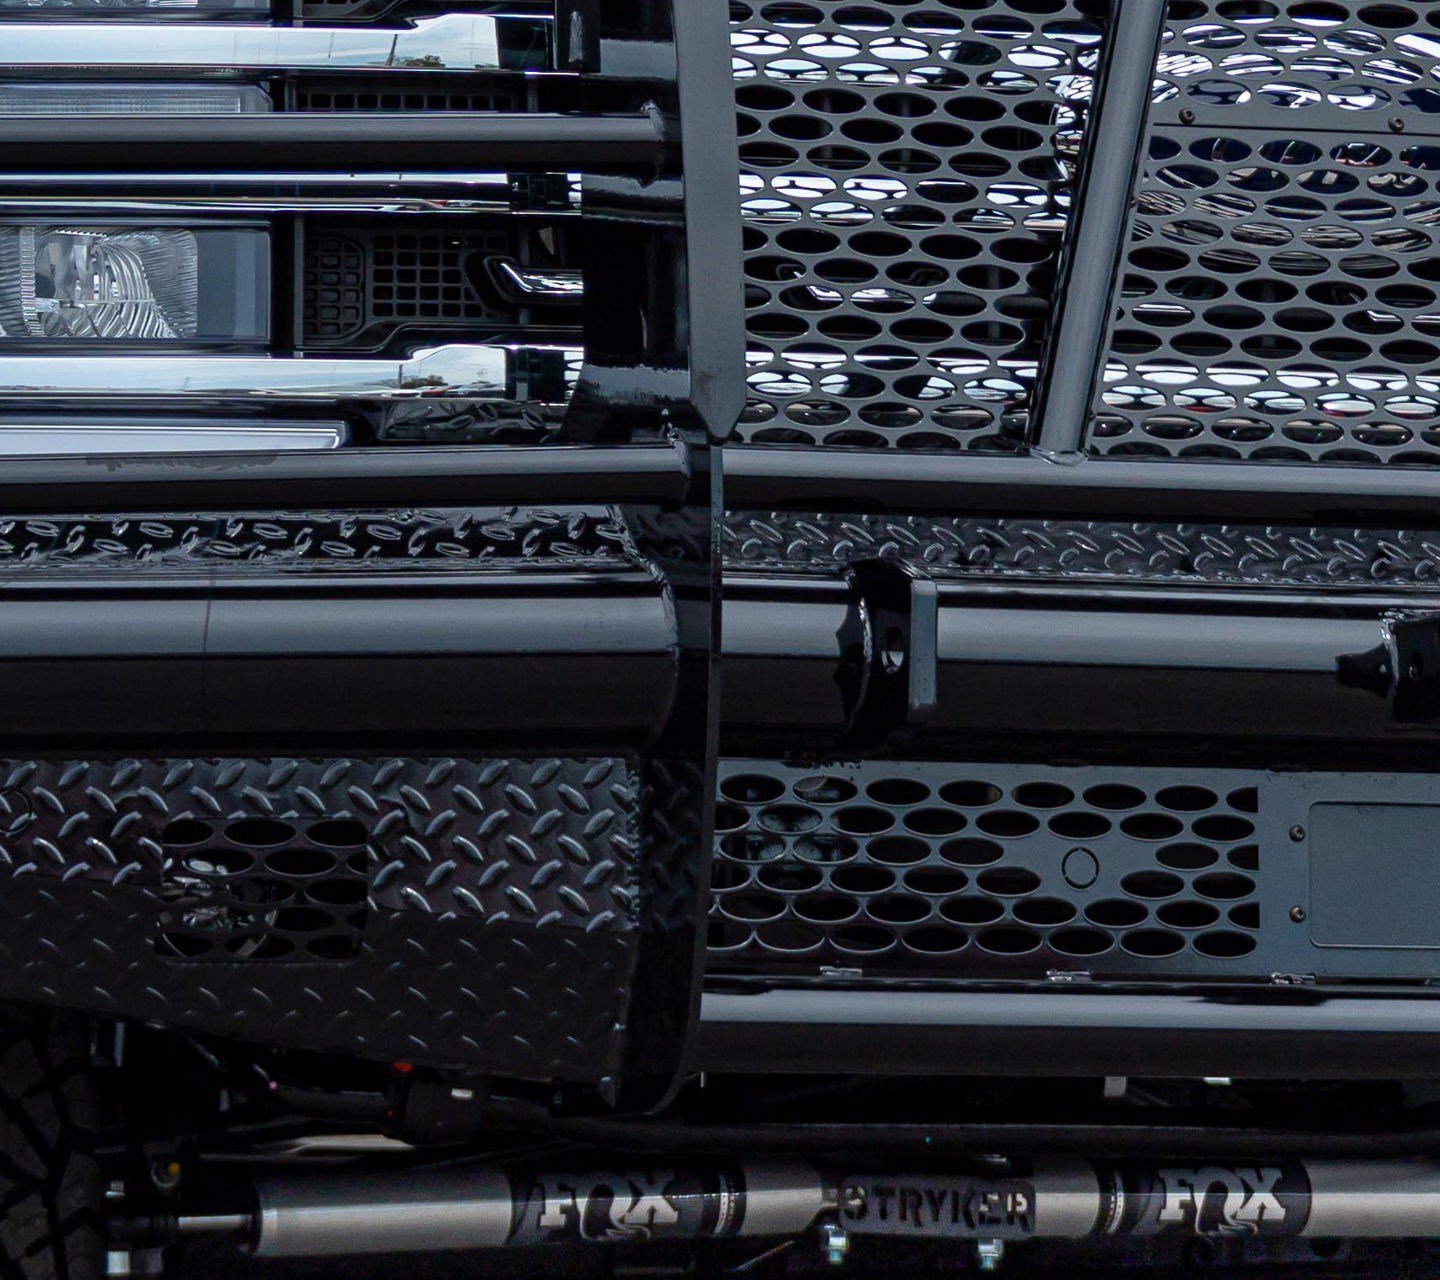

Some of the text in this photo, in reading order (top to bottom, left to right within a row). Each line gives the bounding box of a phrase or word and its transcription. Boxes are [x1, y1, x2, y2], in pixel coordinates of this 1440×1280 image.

[537, 1168, 681, 1240] FOX
[842, 1183, 1031, 1233] STRYKER
[1156, 1165, 1287, 1237] FOX
